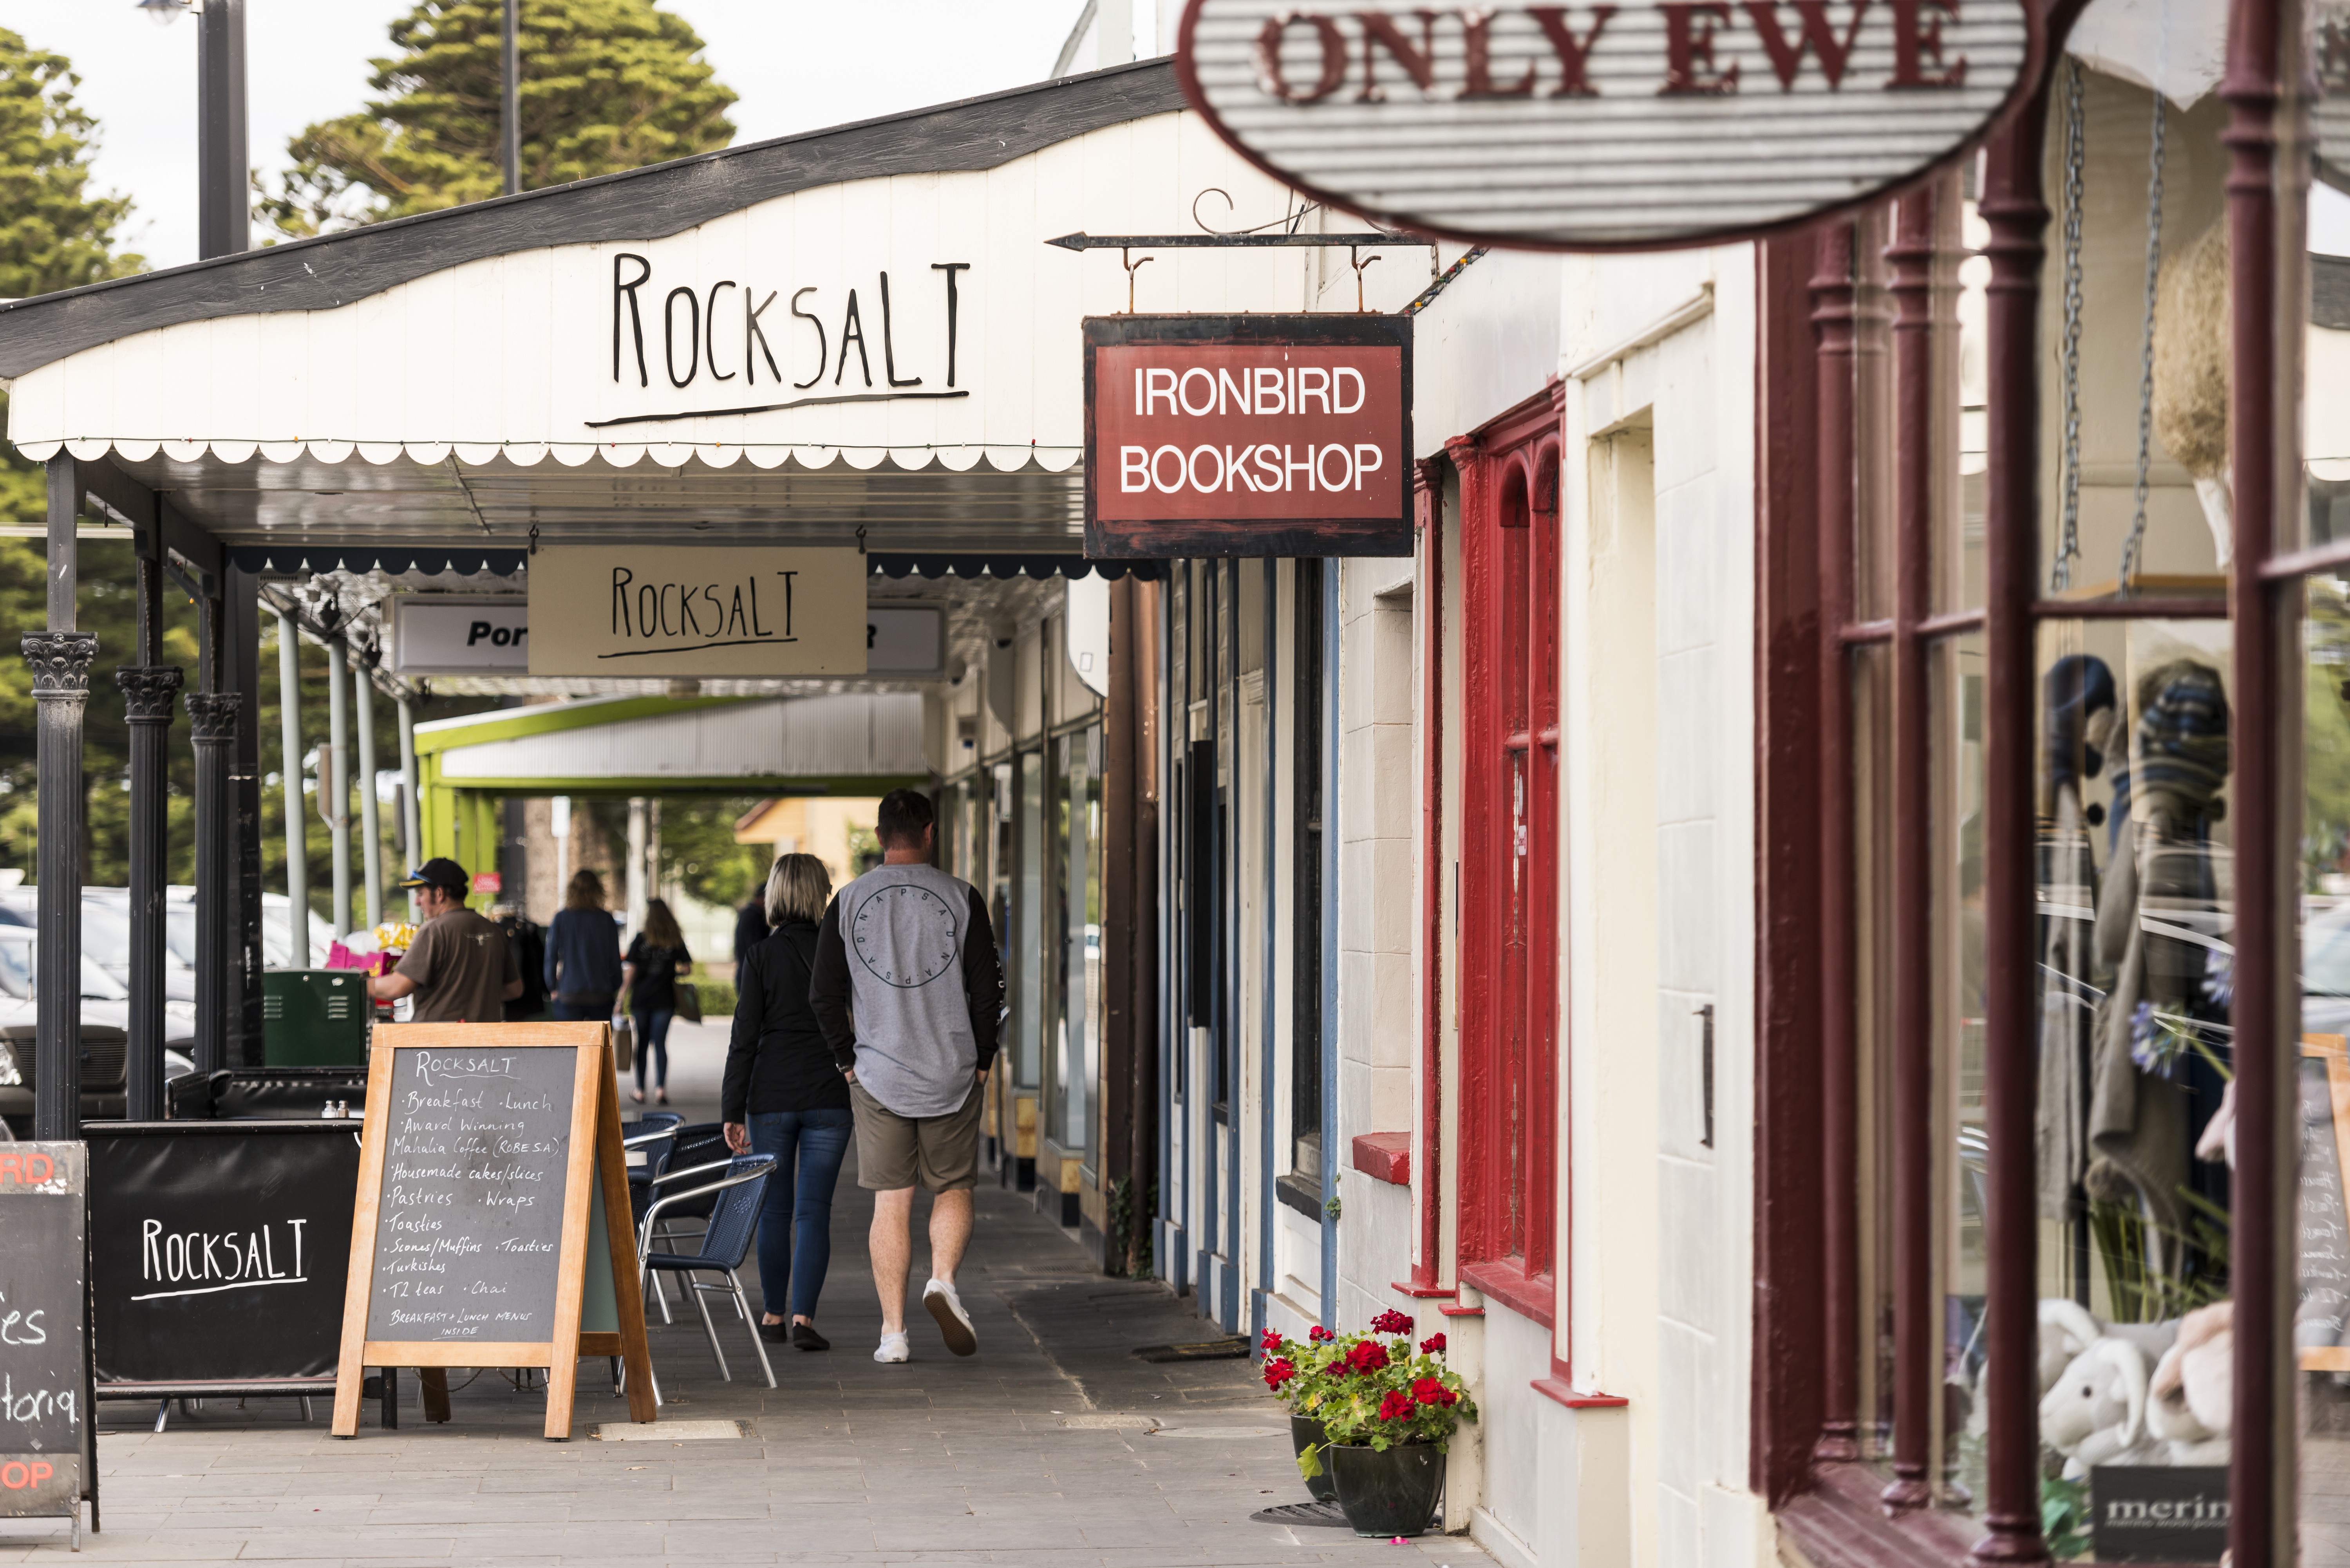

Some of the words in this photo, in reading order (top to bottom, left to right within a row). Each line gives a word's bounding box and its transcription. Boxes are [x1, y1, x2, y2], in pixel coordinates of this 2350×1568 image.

[1252, 5, 1617, 105] ONLY
[1655, 0, 1968, 96] EWE
[614, 253, 970, 388] ROCKSALT
[1135, 367, 1365, 416] IRONBIRD
[1121, 443, 1382, 494] BOOKSHOP
[612, 567, 798, 638] ROCKSALT
[416, 1051, 517, 1086] ROCKSALT
[404, 1089, 483, 1115] Breakfast
[506, 1093, 552, 1111] Lunch
[404, 1117, 452, 1134] Award
[461, 1118, 524, 1138] Winning
[392, 1136, 446, 1156] Mahalia
[454, 1136, 488, 1160] Coffee
[392, 1163, 461, 1182] Housemade
[390, 1185, 453, 1208] Pastries
[486, 1191, 535, 1214] Wraps
[389, 1212, 442, 1232] Toasties
[143, 1219, 307, 1281] ROCKSALT
[501, 1237, 553, 1252] Toasties
[387, 1257, 446, 1275] Turkishes
[416, 1281, 444, 1297] teas
[472, 1281, 507, 1295] Chai
[495, 1312, 532, 1321] MENUS
[441, 1326, 479, 1336] INSIDE
